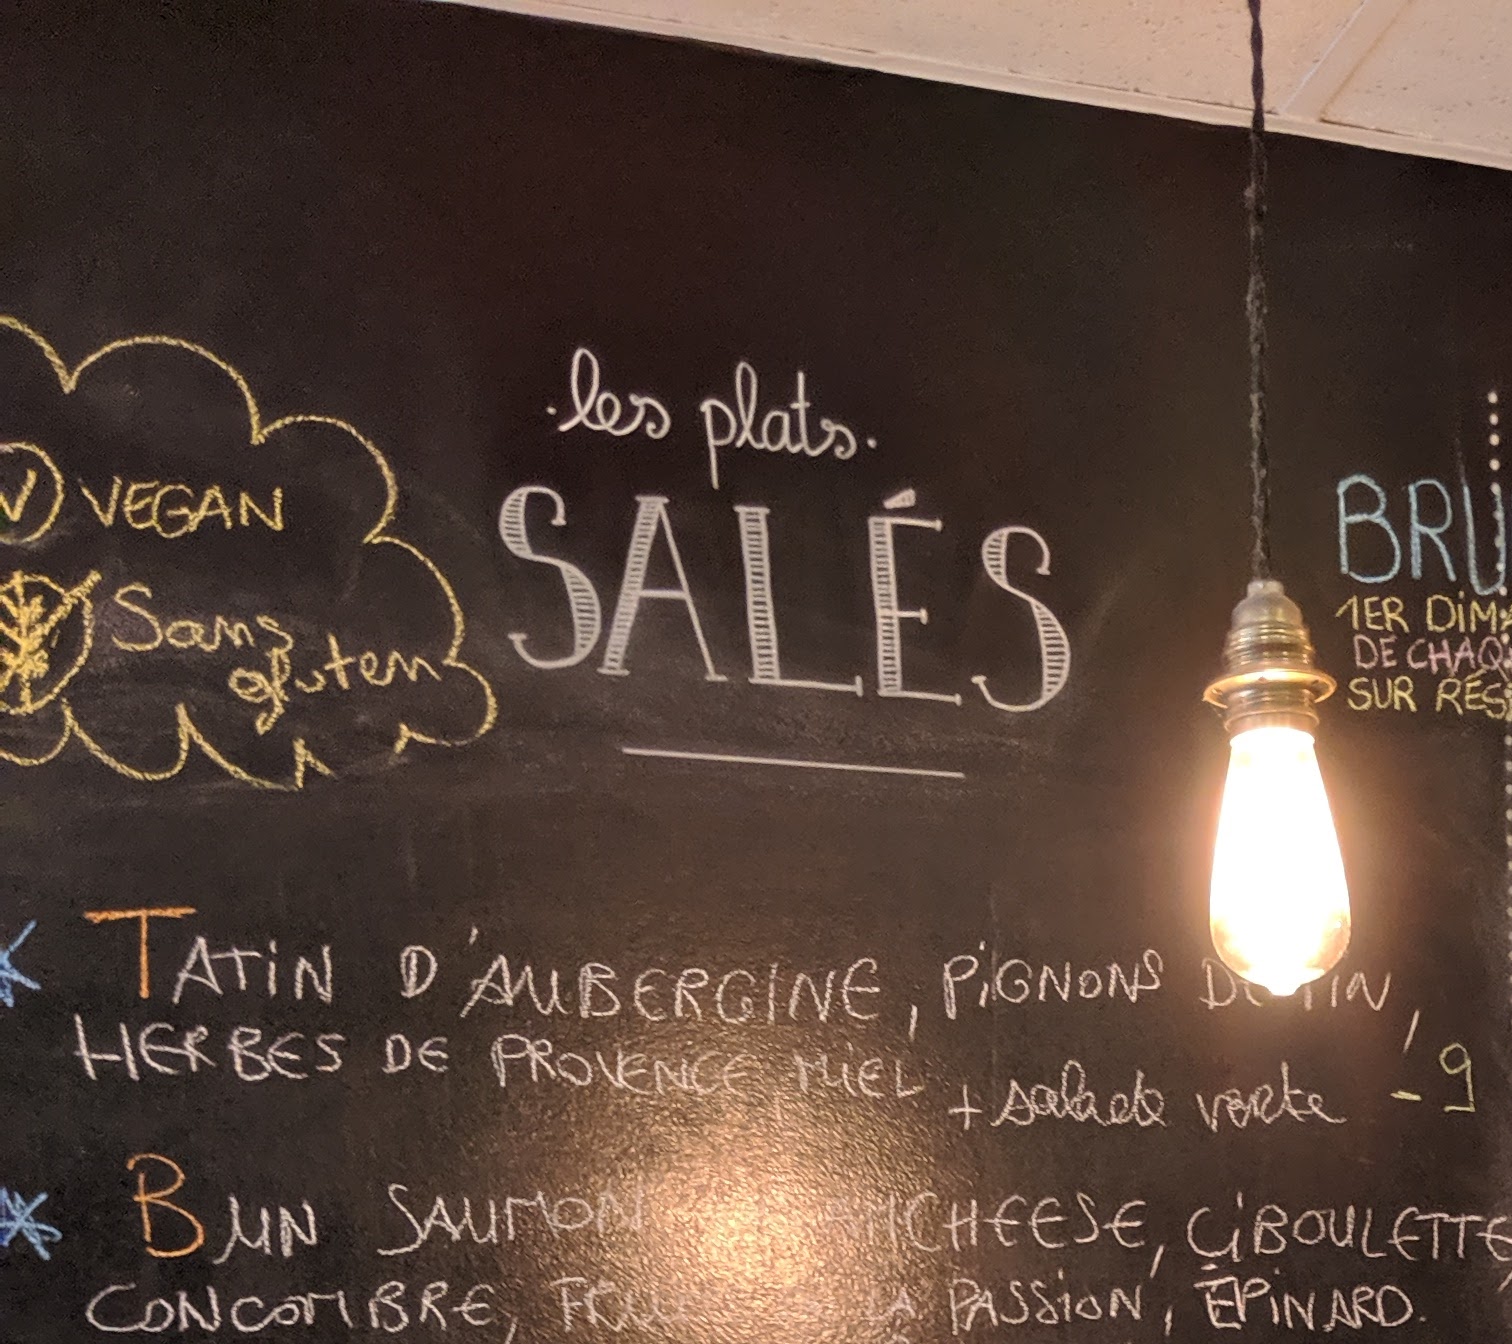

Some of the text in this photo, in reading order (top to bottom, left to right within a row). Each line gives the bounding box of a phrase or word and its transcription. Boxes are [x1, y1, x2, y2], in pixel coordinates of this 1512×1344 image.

[558, 347, 672, 439] les
[81, 476, 284, 538] VEGAN
[112, 582, 295, 652] Sans
[499, 487, 1071, 712] SALÉS
[1354, 635, 1398, 671] DE
[1347, 677, 1417, 713] SUR
[84, 906, 1163, 1020] TATIN PIGNONS
[75, 1013, 345, 1082] HERBES
[382, 1034, 450, 1074] DE
[491, 1032, 768, 1094] PROVENCE
[127, 1153, 319, 1264] BUN
